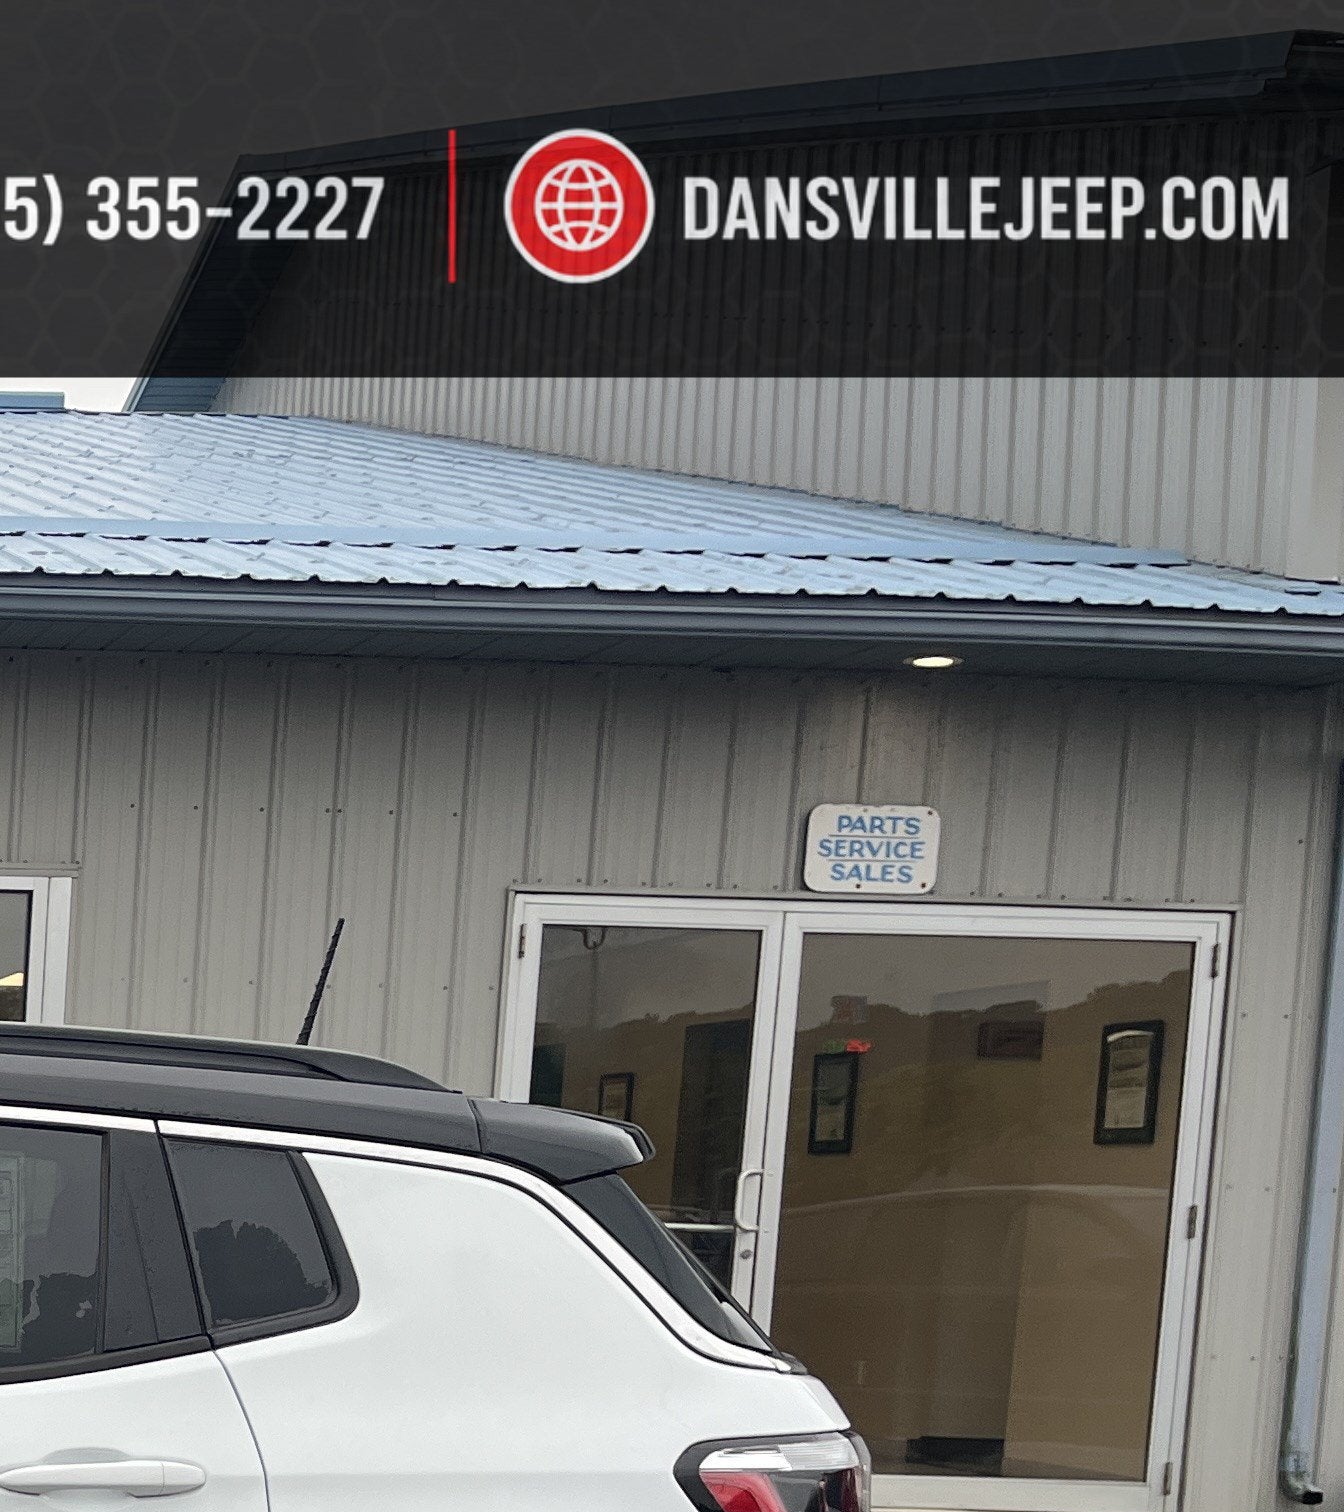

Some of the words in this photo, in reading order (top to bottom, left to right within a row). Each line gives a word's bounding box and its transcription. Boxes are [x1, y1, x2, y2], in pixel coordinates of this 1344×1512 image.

[837, 815, 921, 836] PARTS
[817, 838, 926, 860] SERVICE
[830, 863, 914, 883] SALES
